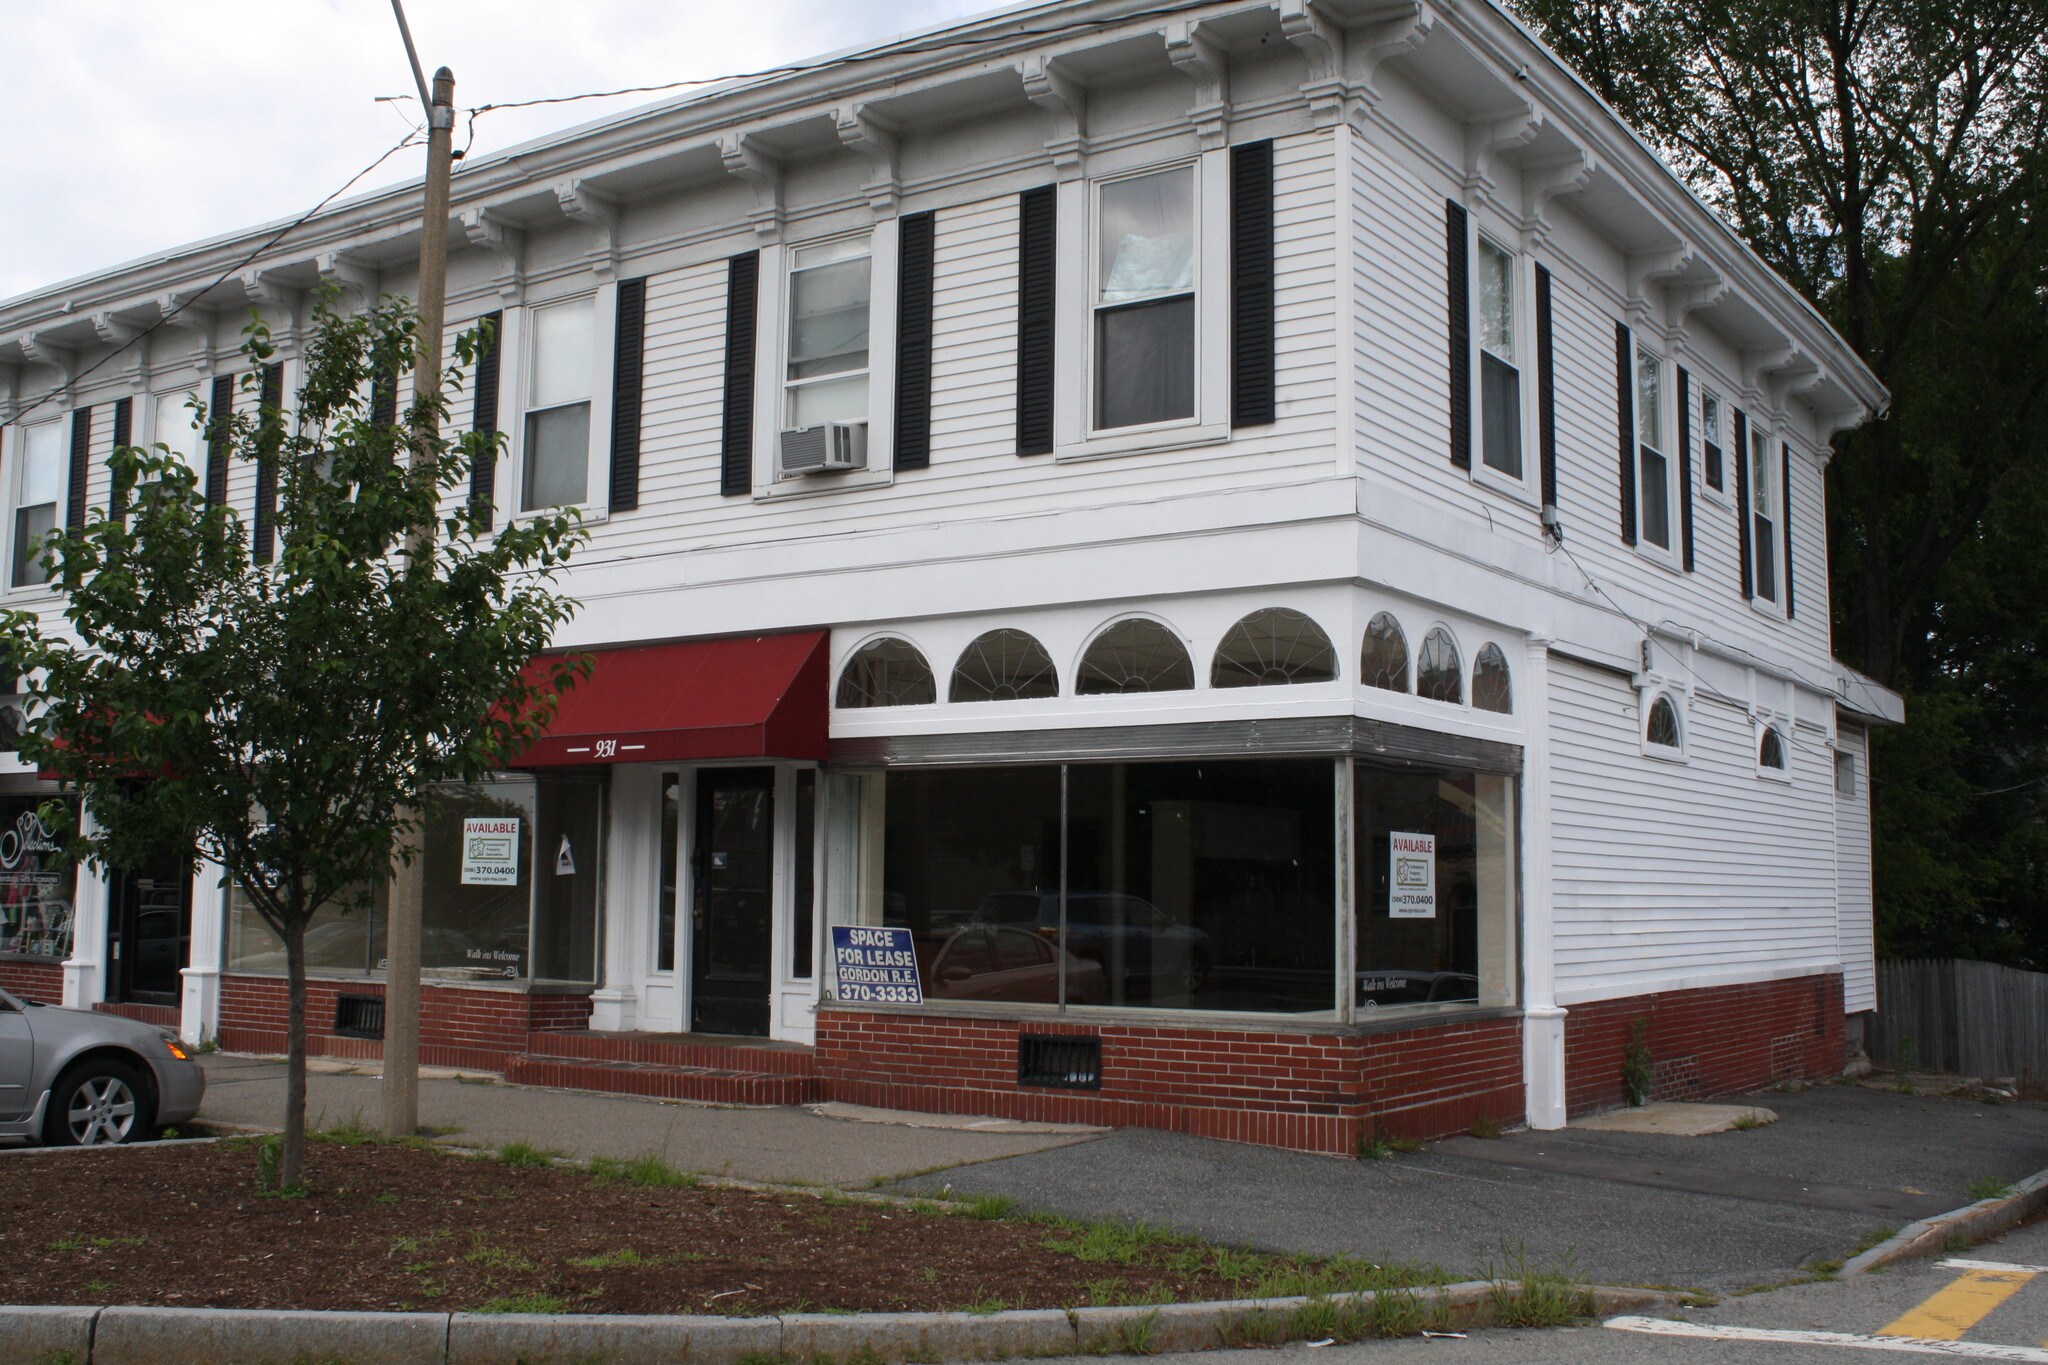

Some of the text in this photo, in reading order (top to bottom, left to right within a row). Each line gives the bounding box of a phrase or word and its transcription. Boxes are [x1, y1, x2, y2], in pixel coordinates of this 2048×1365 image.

[593, 739, 617, 758] 931
[466, 823, 517, 834] AVAILABLE
[1393, 838, 1433, 853] AVAILABLE
[476, 866, 516, 875] 370.0400
[1402, 895, 1434, 905] 370.0400
[850, 929, 894, 946] SPACE
[466, 948, 521, 961] Walk ins Welcome
[837, 947, 913, 966] FOR LEASE
[839, 967, 916, 983] GORDON R.E.
[1363, 977, 1376, 992] Walk
[1385, 975, 1407, 990] Welcome
[840, 983, 919, 1002] 370-3333
